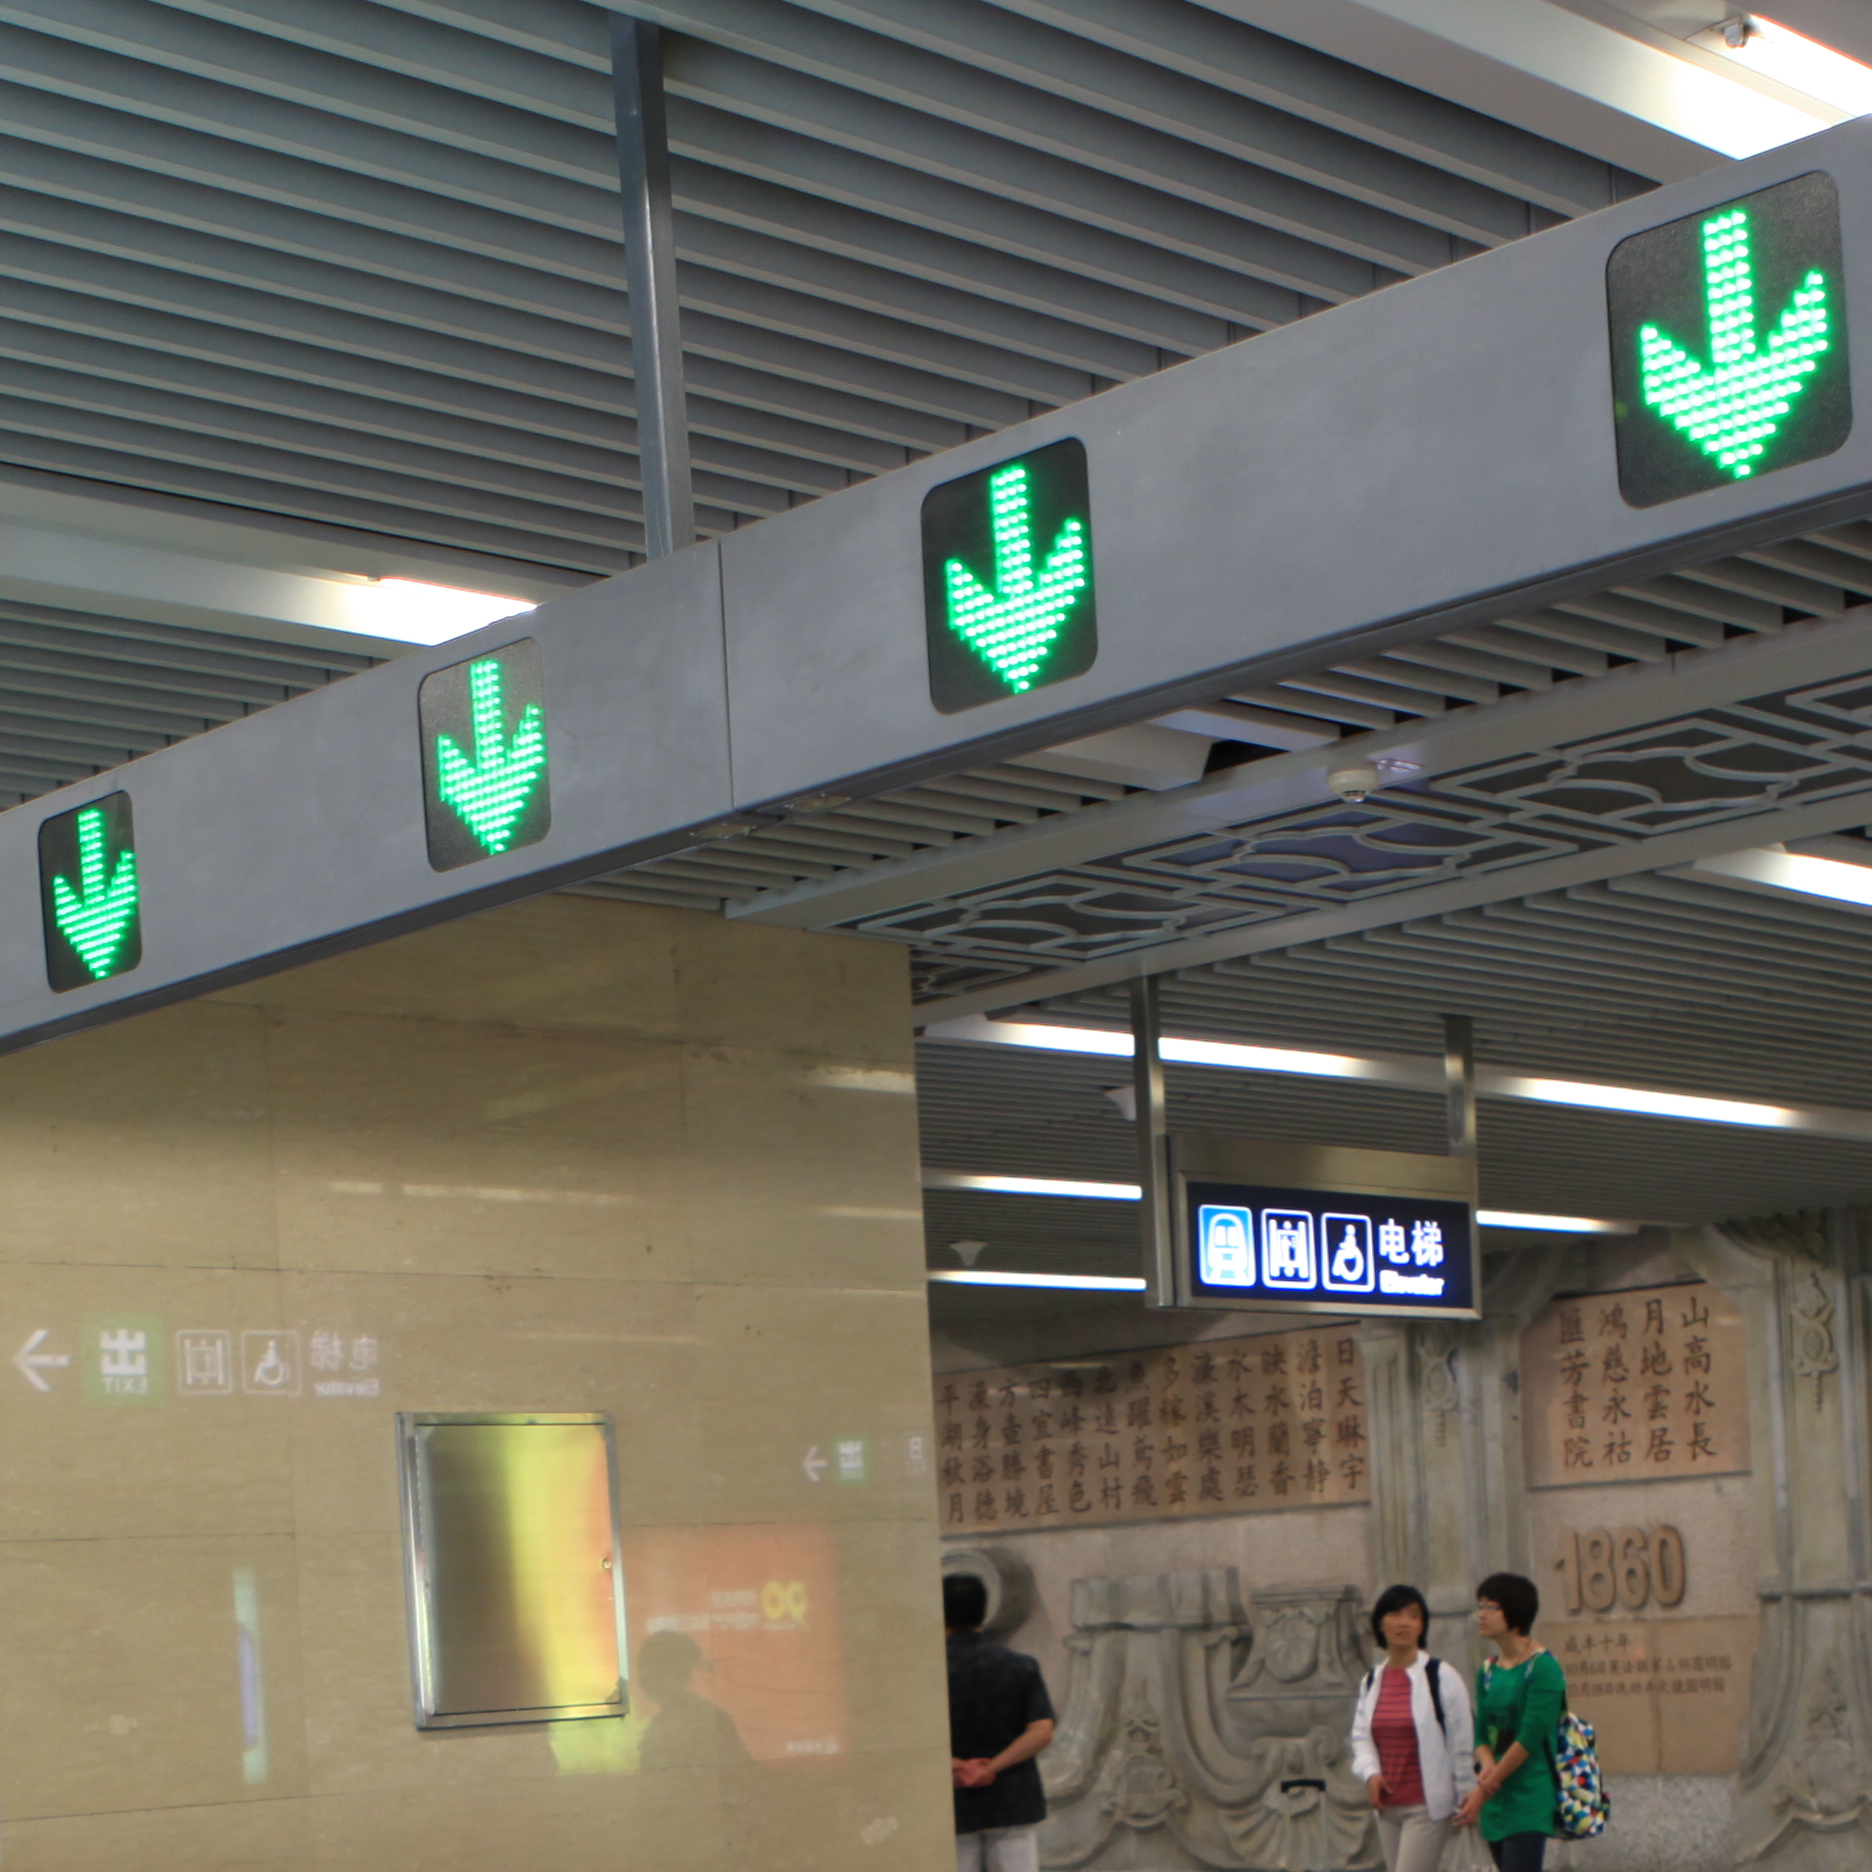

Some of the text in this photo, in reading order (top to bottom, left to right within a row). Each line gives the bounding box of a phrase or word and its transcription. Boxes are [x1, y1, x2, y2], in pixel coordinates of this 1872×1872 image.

[1379, 1217, 1445, 1267] 电梯
[1379, 1269, 1445, 1297] Elevator
[1640, 1297, 1676, 1464] 月地雲居
[1681, 1296, 1718, 1462] 山高水長
[1554, 1523, 1687, 1617] 1860
